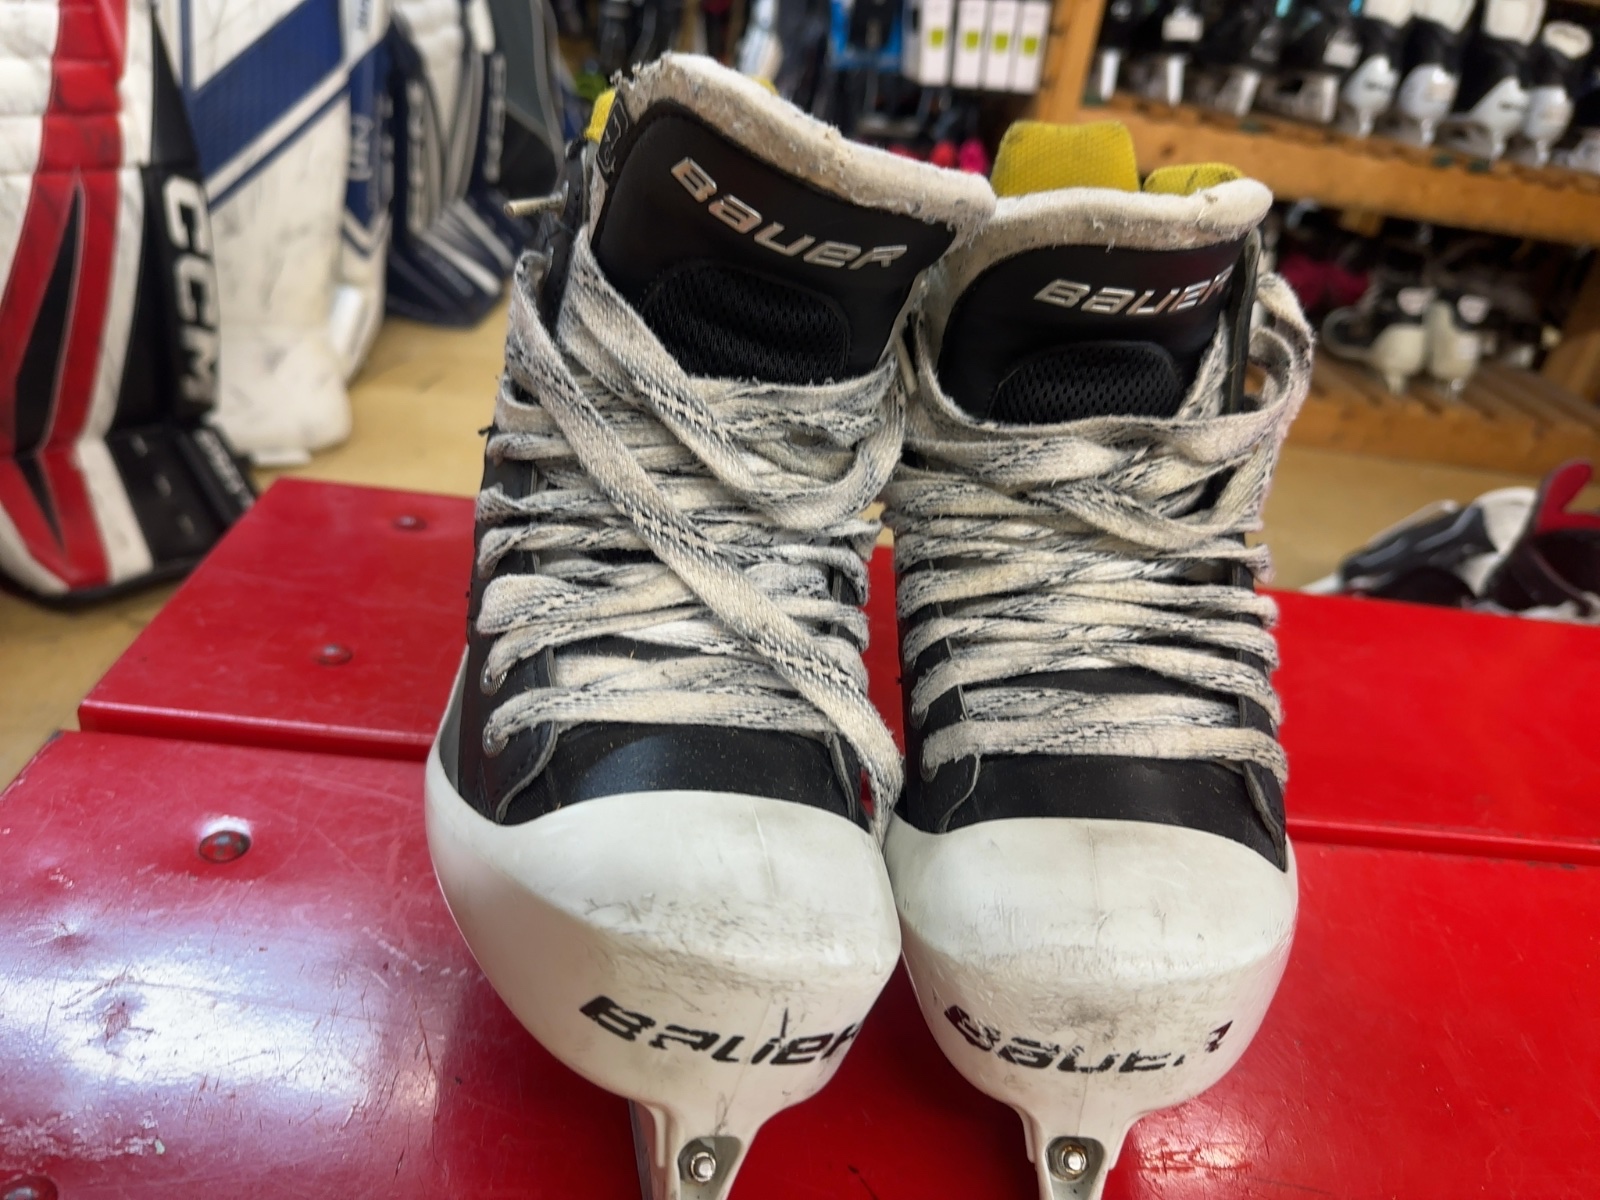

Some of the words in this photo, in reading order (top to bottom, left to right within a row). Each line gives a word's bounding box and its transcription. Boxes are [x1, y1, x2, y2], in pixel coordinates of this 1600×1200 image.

[671, 156, 907, 270] BAUER
[163, 175, 218, 401] CCM
[1033, 264, 1234, 316] BAUER
